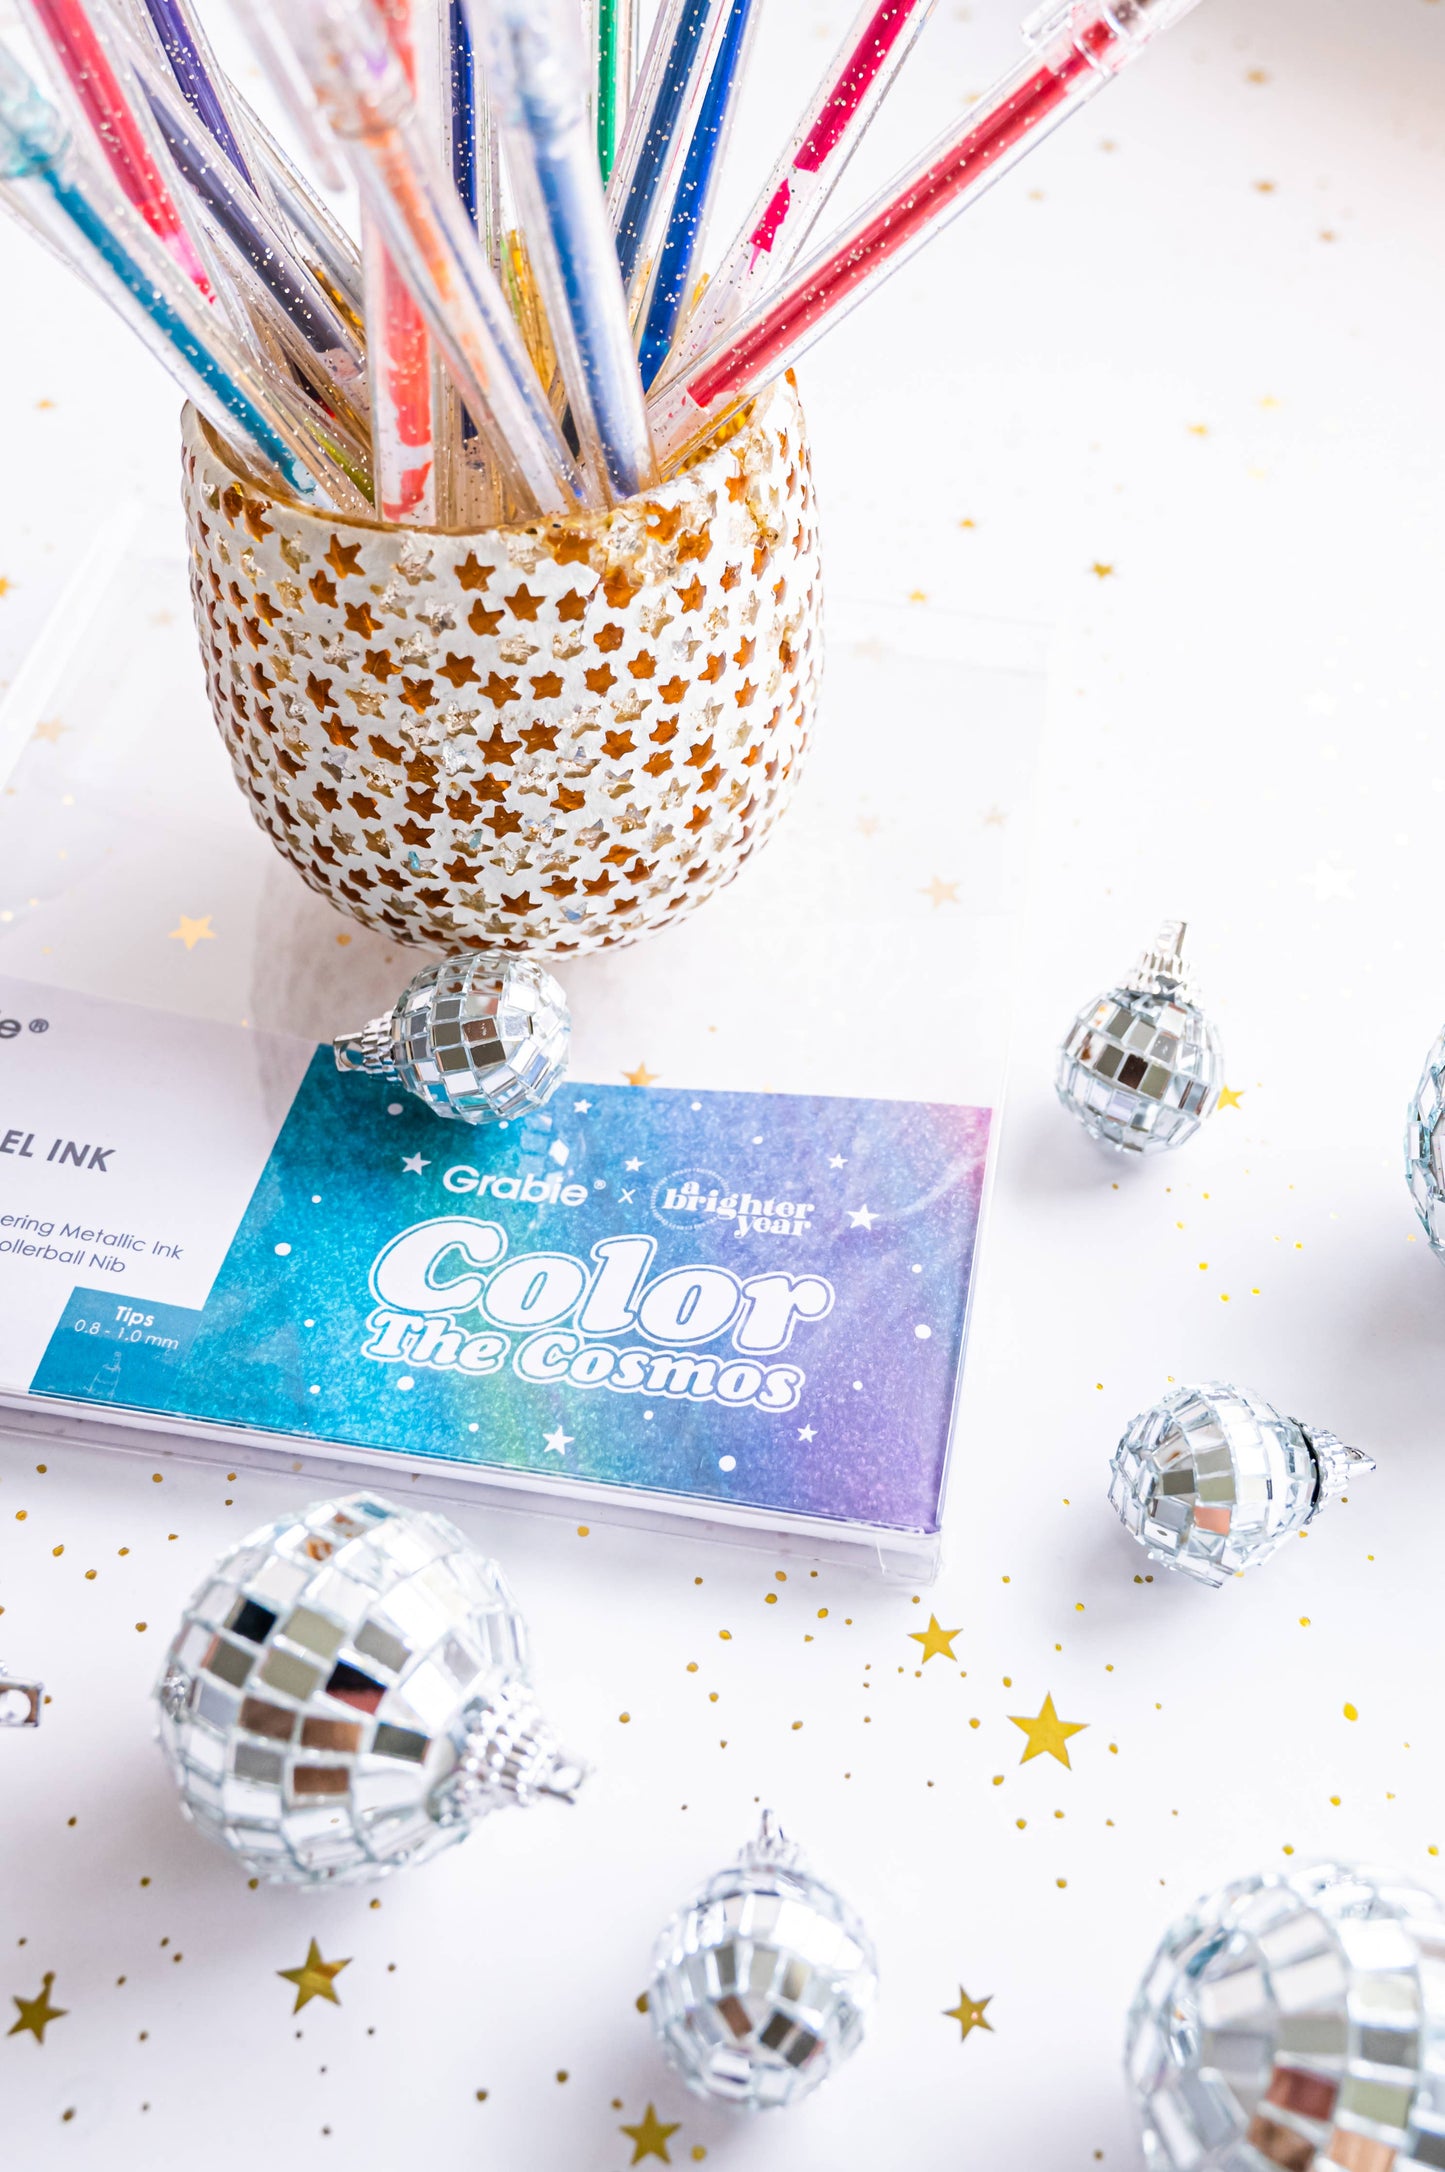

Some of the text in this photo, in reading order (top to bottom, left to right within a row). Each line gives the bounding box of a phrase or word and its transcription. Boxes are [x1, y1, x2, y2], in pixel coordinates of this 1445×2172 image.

[47, 1138, 116, 1172] INK
[662, 1188, 815, 1220] brighter
[680, 1181, 700, 1196] a
[0, 1214, 184, 1260] ering Metallic Ink
[734, 1214, 811, 1238] year
[0, 1239, 126, 1273] ollerball Nib
[368, 1216, 835, 1356] Color
[115, 1305, 155, 1327] Tips
[74, 1319, 101, 1335] 0.8
[118, 1327, 142, 1342] 1.0
[145, 1335, 179, 1350] mm
[361, 1308, 806, 1413] The Cosmos
